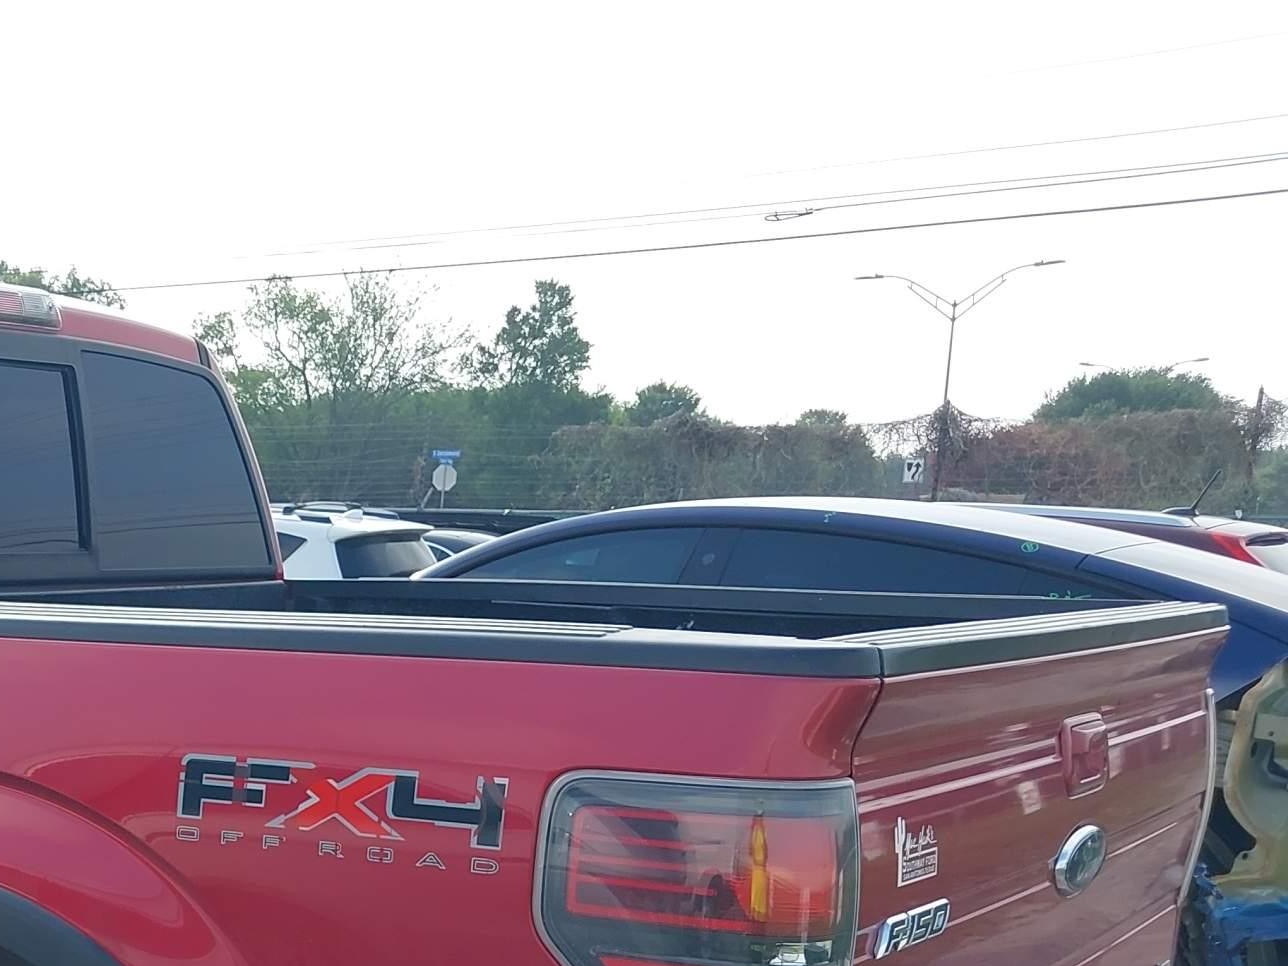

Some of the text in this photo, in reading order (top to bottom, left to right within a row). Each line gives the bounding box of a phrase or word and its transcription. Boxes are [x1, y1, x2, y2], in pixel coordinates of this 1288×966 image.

[176, 753, 509, 850] FX4
[176, 825, 500, 875] OFF ROAD
